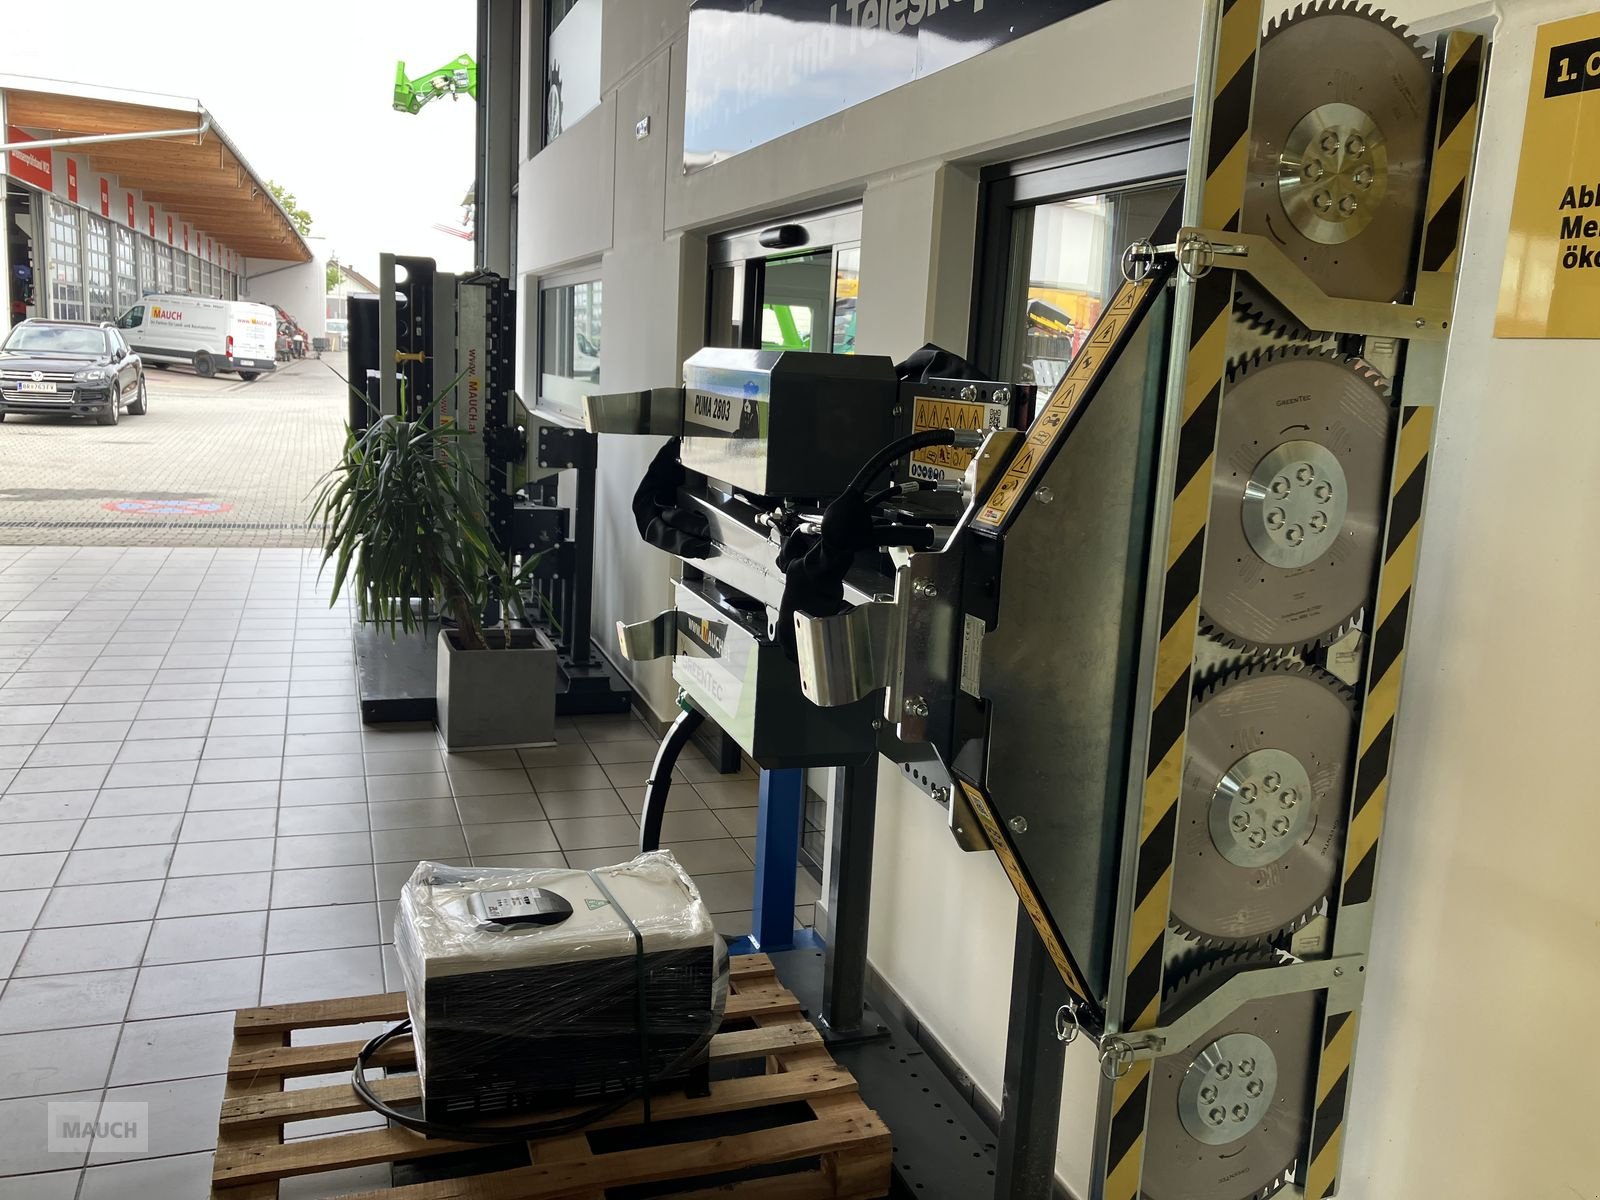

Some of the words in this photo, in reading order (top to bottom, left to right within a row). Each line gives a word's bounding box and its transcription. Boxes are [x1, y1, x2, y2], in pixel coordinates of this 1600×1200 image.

[1557, 57, 1578, 83] 1.
[1560, 215, 1600, 240] Me
[153, 308, 183, 321] MAUCH
[694, 394, 712, 418] PUMA
[712, 397, 731, 421] 2803
